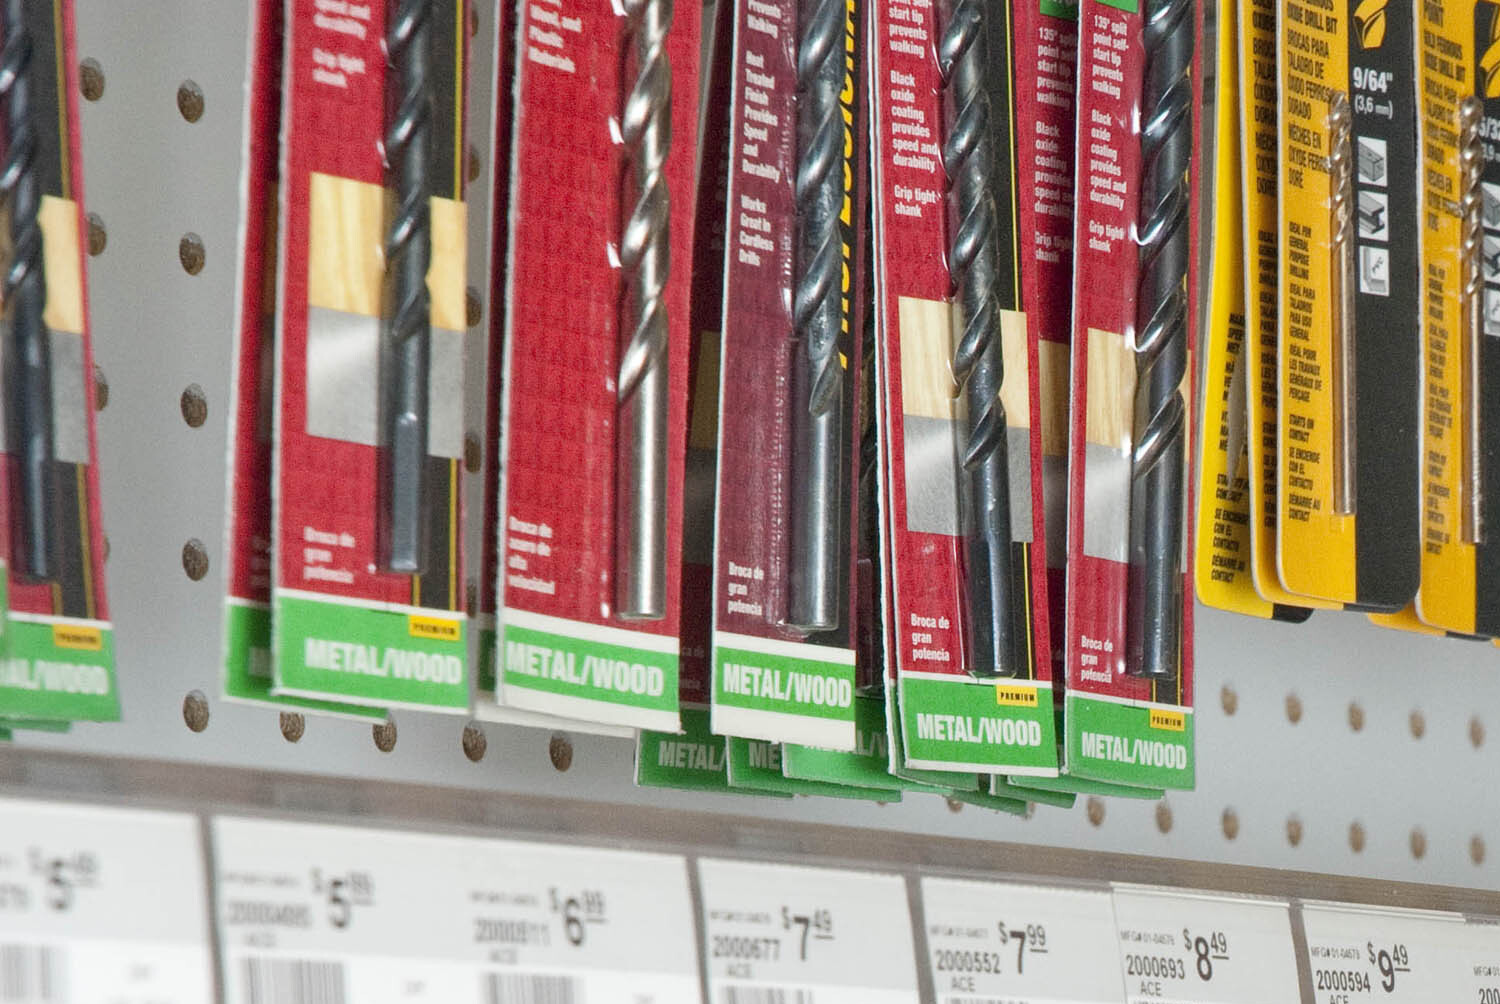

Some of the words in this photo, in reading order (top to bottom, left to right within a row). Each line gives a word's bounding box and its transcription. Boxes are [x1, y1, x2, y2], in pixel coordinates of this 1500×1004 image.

[890, 70, 915, 86] Black
[1353, 67, 1393, 93] 9/64"
[891, 90, 915, 103] oxide
[892, 105, 924, 122] coating
[892, 122, 930, 138] provides
[893, 138, 918, 156] speed
[921, 143, 938, 155] and
[893, 154, 936, 173] durability
[894, 185, 913, 201] Grip
[915, 188, 936, 204] tight
[895, 203, 922, 217] shank
[729, 561, 750, 579] Broca
[753, 566, 764, 580] de
[728, 581, 748, 596] gran
[728, 599, 763, 616] potencia
[911, 613, 936, 628] Broca
[938, 616, 950, 629] de
[912, 632, 931, 645] gran
[1081, 635, 1102, 651] Broca
[1104, 640, 1112, 652] de
[304, 638, 462, 684] METAL/WOOD
[912, 648, 950, 662] potencia
[1081, 653, 1098, 666] gran
[506, 641, 664, 696] METAL/WOOD
[1081, 668, 1112, 684] potencia
[723, 663, 851, 708] METAL/WOOD
[1000, 692, 1035, 702] PREMIUM
[916, 713, 1041, 746] METAL/WOOD
[1081, 732, 1187, 770] METAL/WOOD
[936, 950, 1001, 974] 2000552
[1126, 954, 1185, 980] 2000693
[951, 977, 975, 992] ACE
[1140, 982, 1162, 996] ACE
[1317, 970, 1370, 992] 2000594
